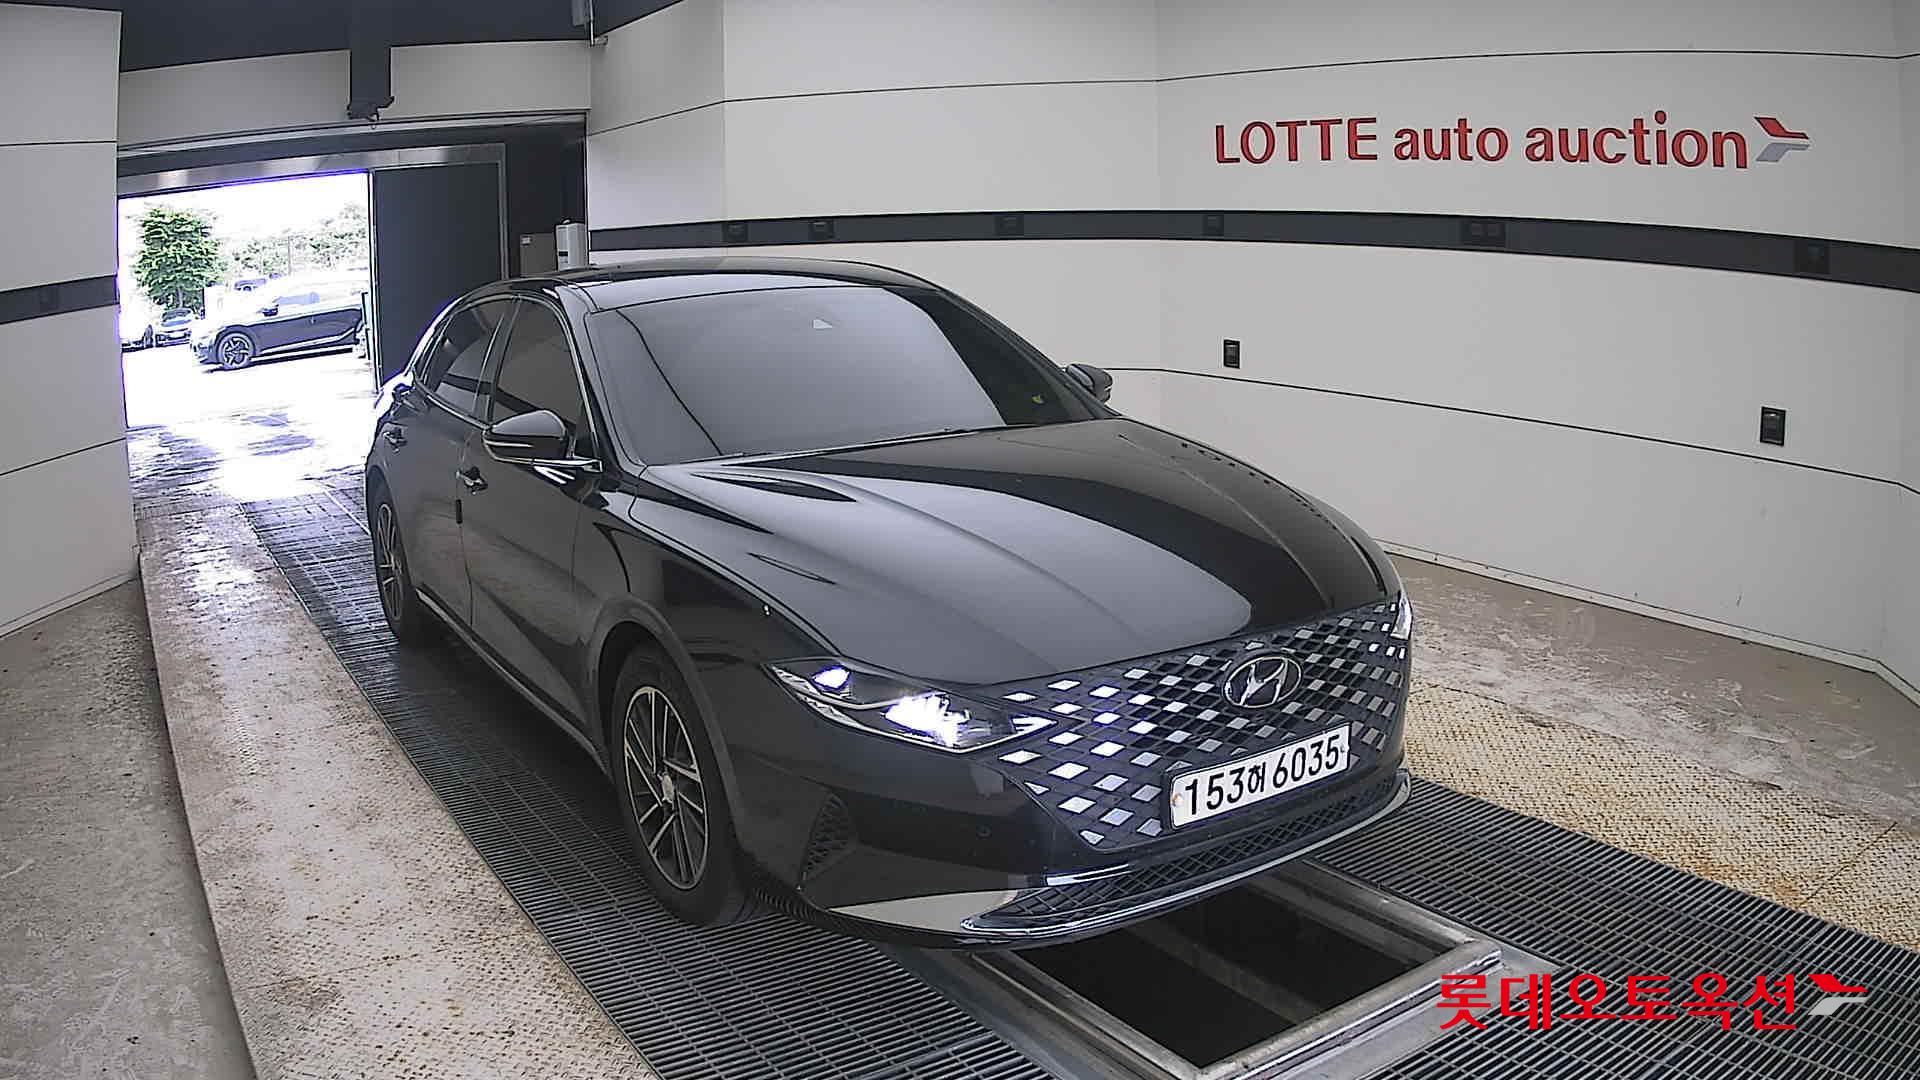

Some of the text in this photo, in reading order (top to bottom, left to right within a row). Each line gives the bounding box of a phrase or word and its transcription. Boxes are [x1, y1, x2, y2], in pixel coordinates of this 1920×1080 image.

[1215, 110, 1748, 169] LOTTE auto auction
